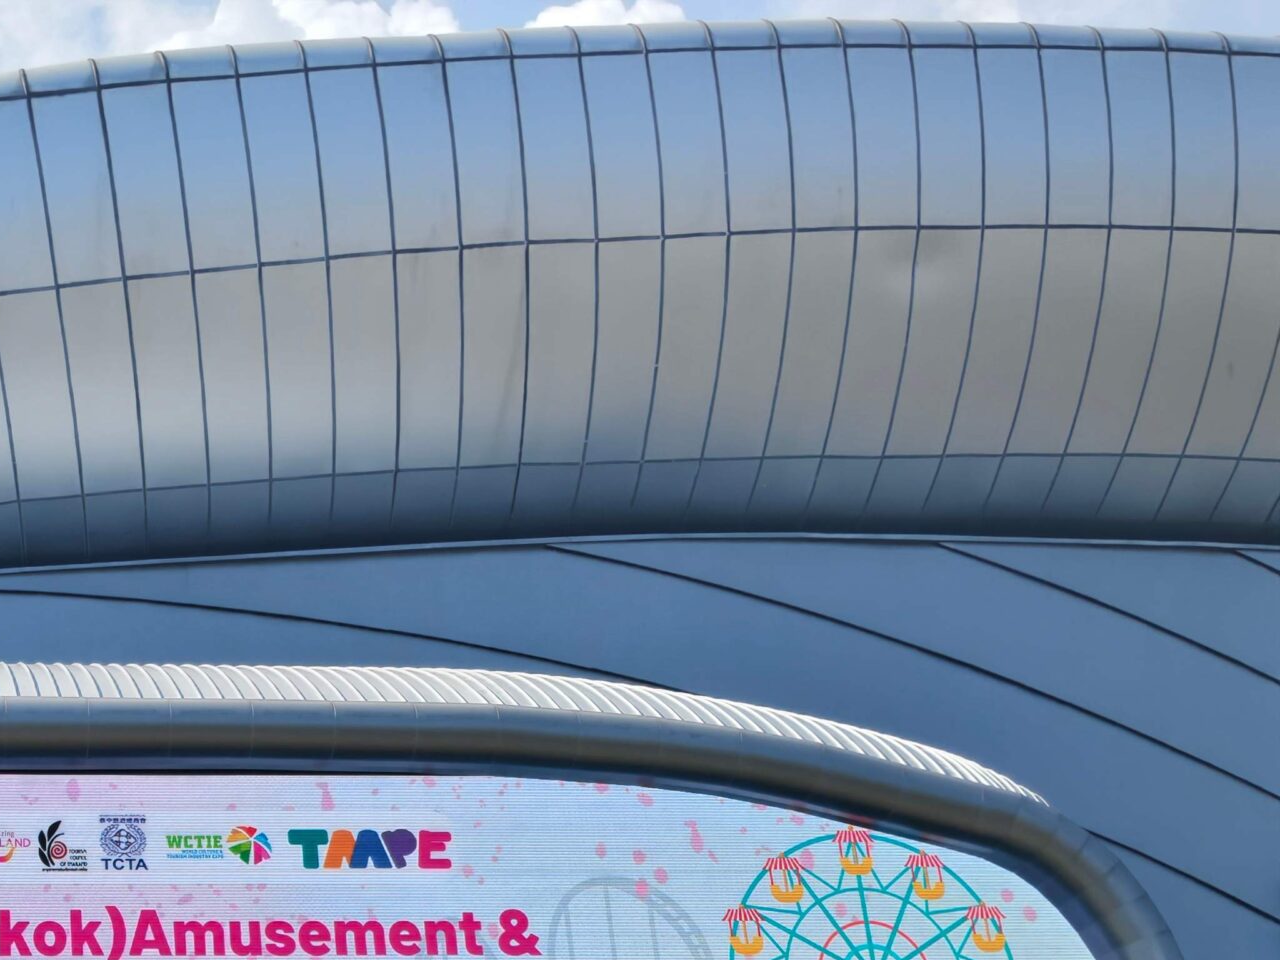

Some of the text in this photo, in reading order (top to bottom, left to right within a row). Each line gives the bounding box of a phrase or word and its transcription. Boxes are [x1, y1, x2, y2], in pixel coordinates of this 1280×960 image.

[166, 835, 223, 849] WCTIE
[101, 858, 149, 871] TCTA
[497, 908, 543, 956] &
